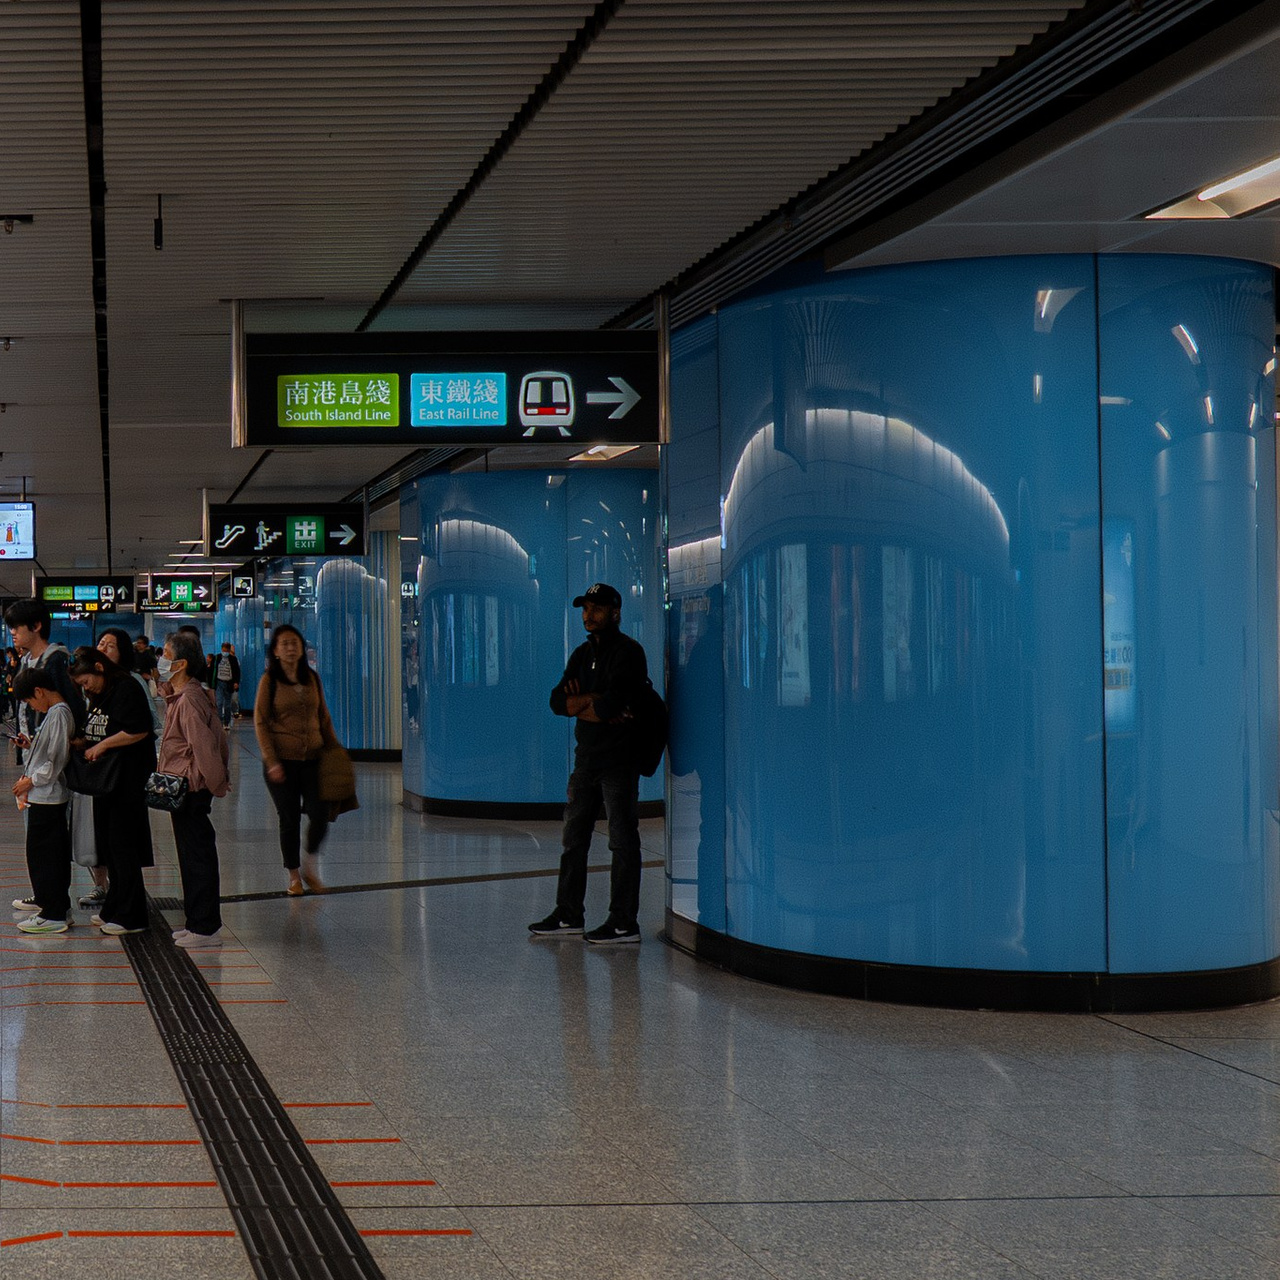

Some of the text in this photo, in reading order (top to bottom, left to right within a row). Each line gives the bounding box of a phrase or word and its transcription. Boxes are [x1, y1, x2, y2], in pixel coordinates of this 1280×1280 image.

[284, 380, 391, 406] 南港島綫
[419, 379, 499, 405] 東鐵綫
[285, 408, 391, 421] South Island Line
[419, 408, 499, 420] East Rail Line
